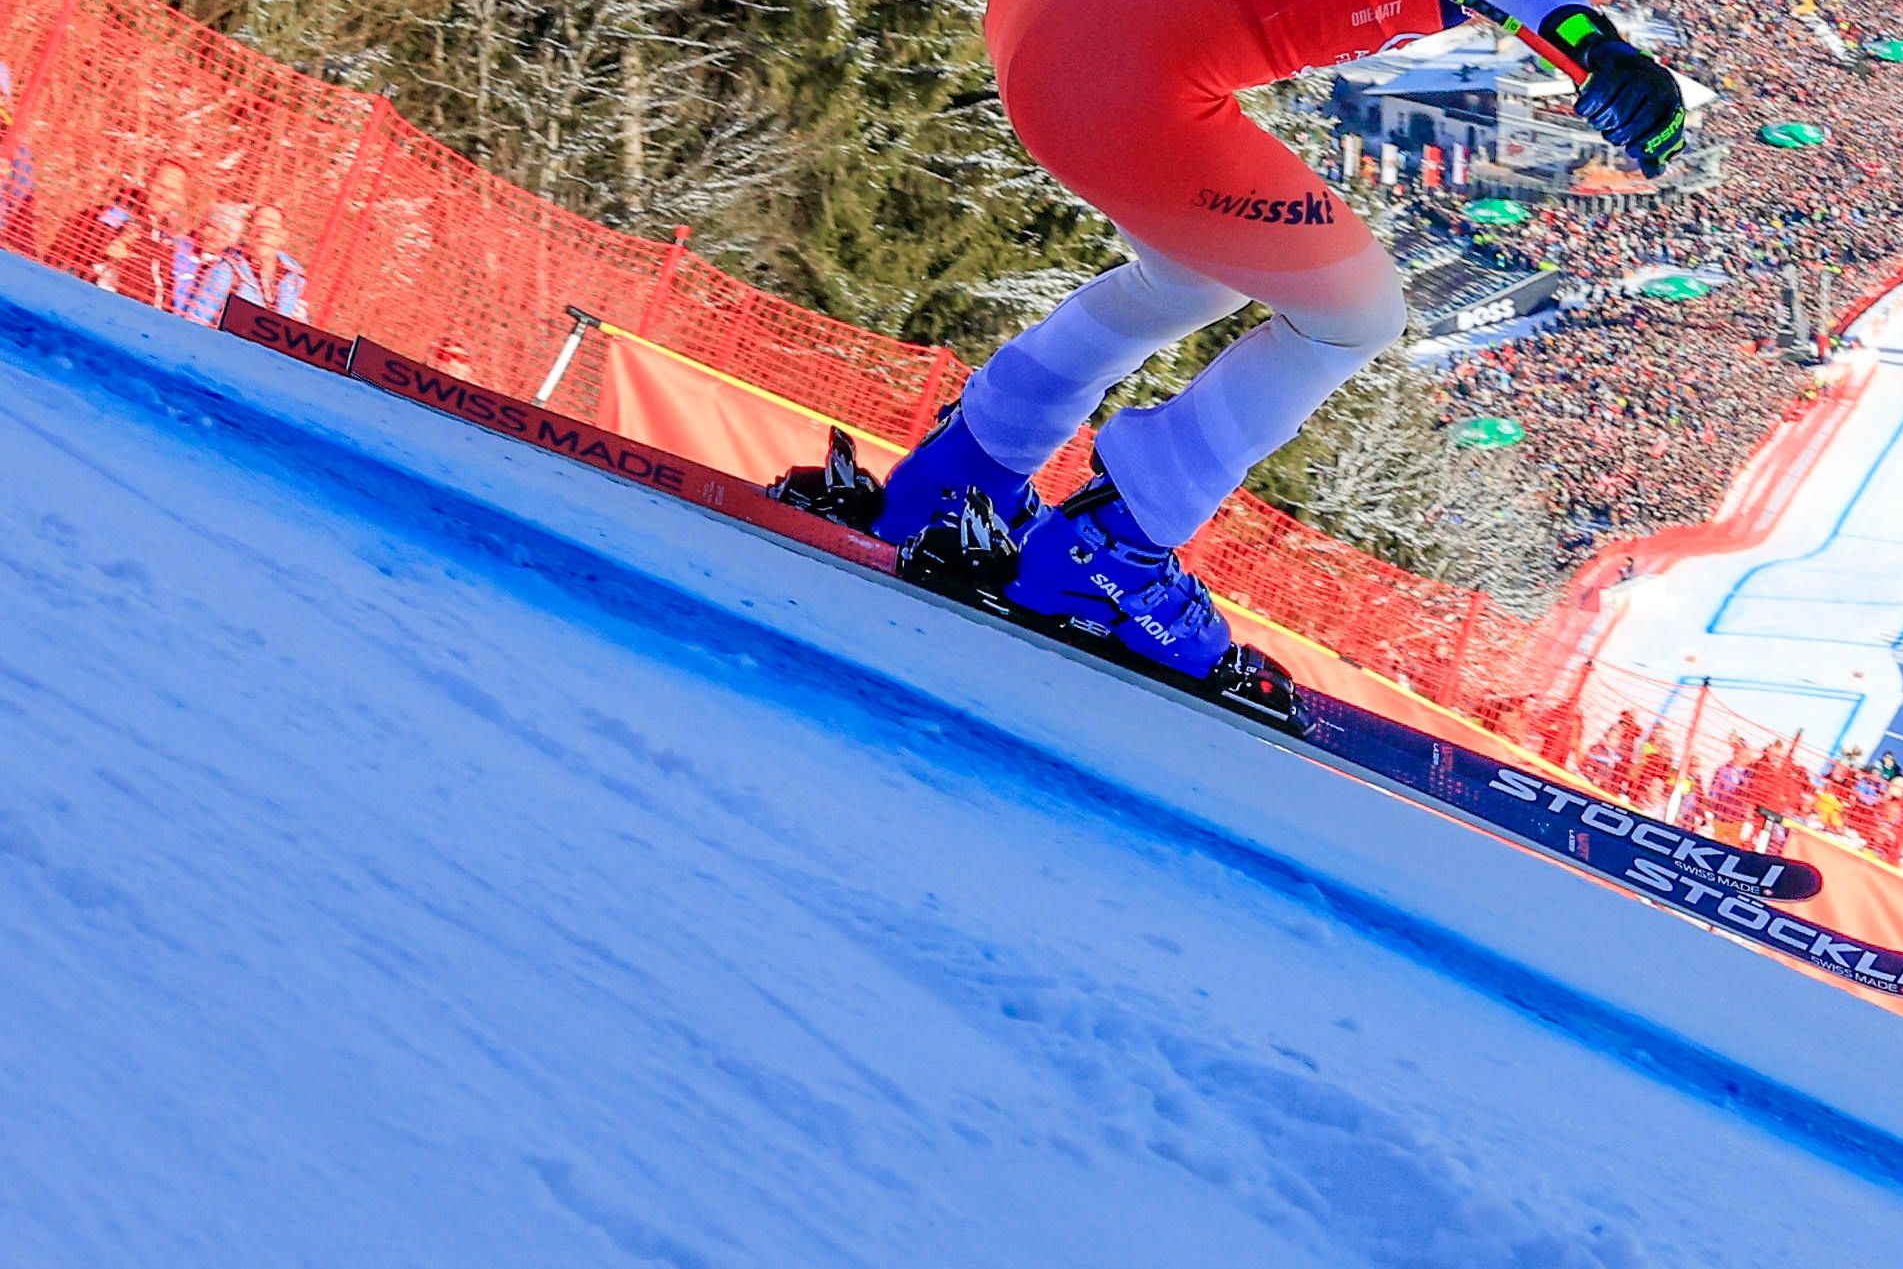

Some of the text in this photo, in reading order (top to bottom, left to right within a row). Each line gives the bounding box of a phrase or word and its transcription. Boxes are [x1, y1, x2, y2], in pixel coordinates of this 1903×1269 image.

[1457, 297, 1517, 332] BOSS
[382, 358, 686, 491] SWISS MADE
[1488, 768, 1786, 888] STÖCKLI
[1674, 860, 1761, 895] SWISS MADE
[1811, 955, 1899, 994] SWISS MADE
